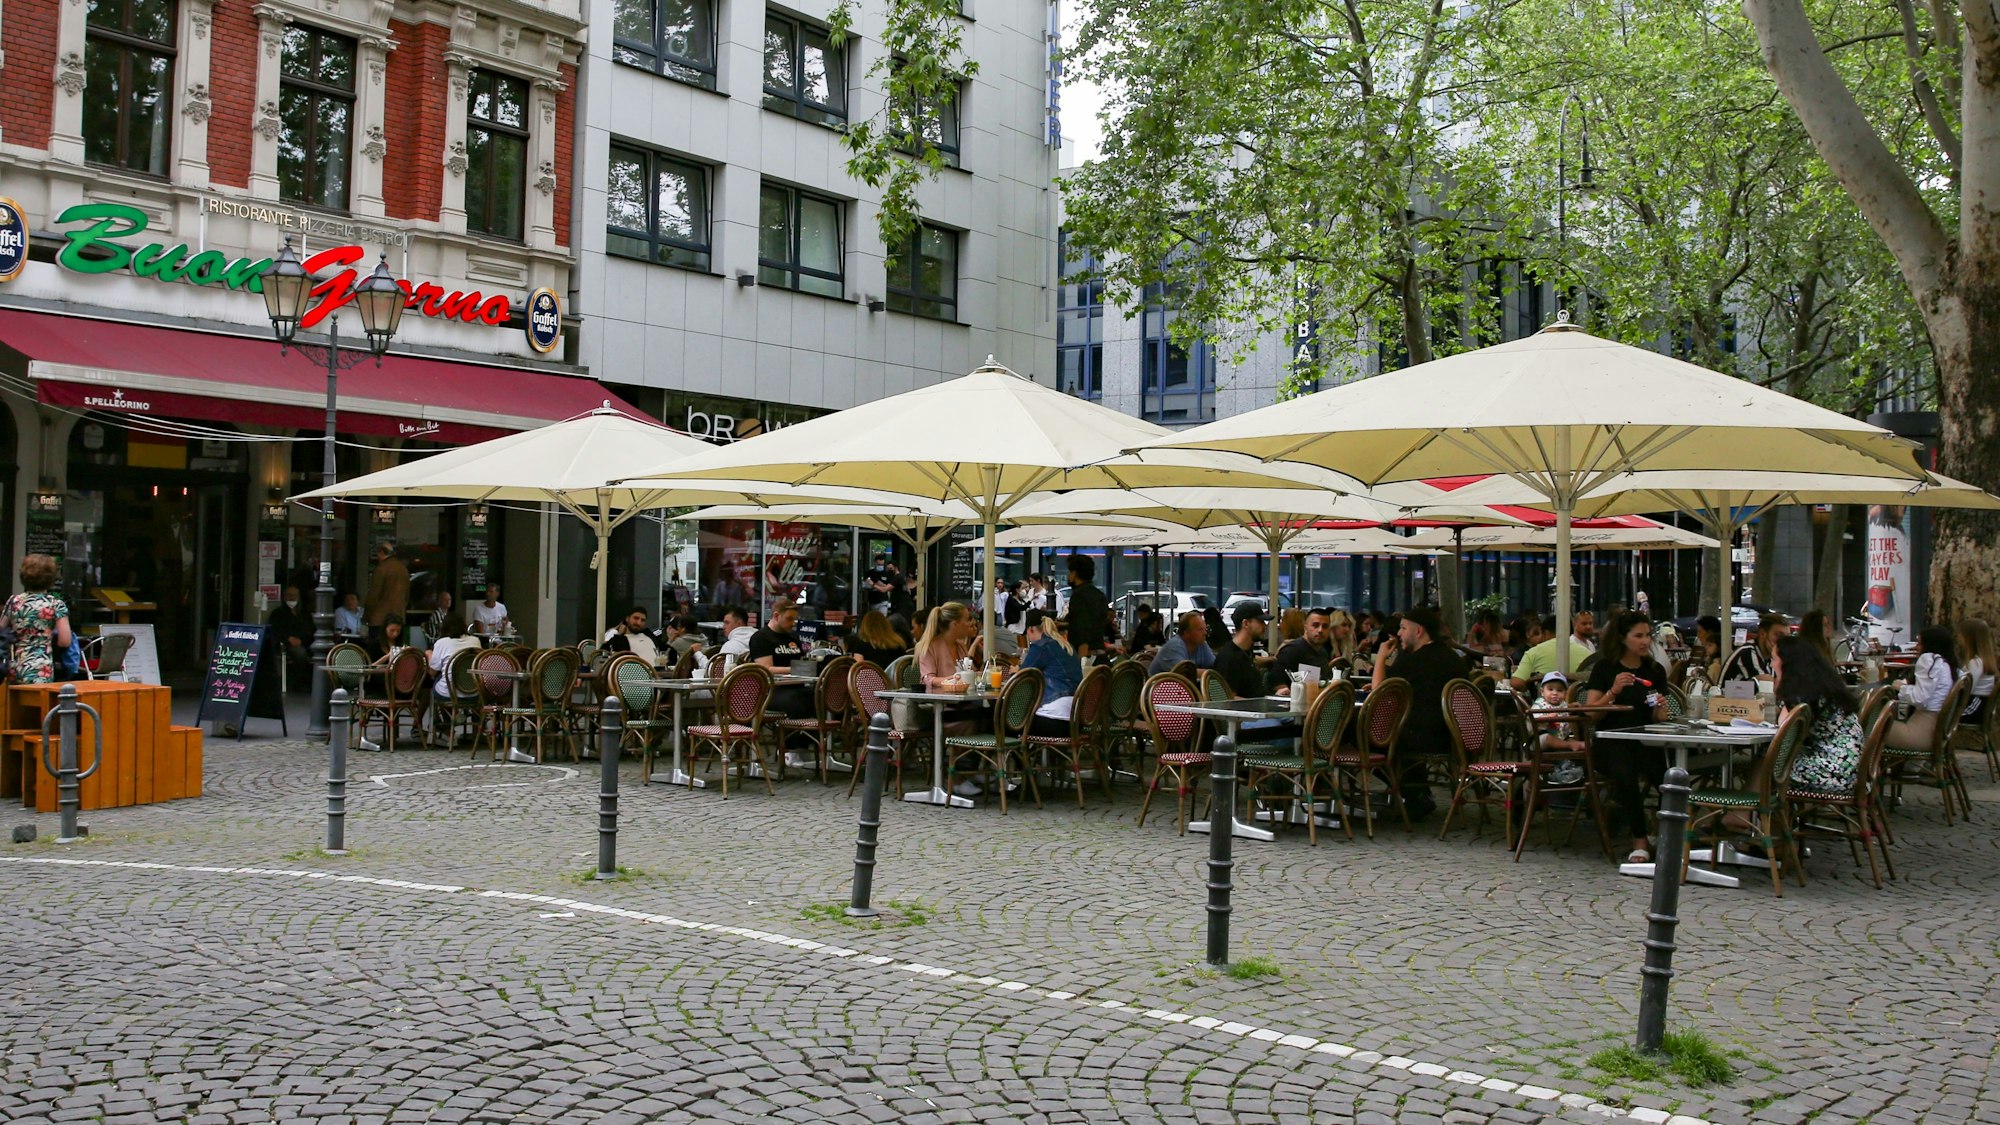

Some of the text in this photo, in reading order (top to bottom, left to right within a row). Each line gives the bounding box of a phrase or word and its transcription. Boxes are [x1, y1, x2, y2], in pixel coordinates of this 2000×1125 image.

[208, 198, 407, 249] RISTORANTE PIZZERIA BISTRO
[54, 203, 511, 328] Buon Grno
[533, 311, 558, 327] Gaffel
[84, 396, 150, 410] S.PELLEGRINO
[426, 420, 440, 430] Bit
[1878, 537, 1898, 551] THE
[1871, 567, 1890, 581] PLAY
[218, 645, 249, 658] Wir sind
[214, 665, 229, 674] Sie
[216, 658, 254, 670] wieder für
[1717, 707, 1750, 715] HOME
